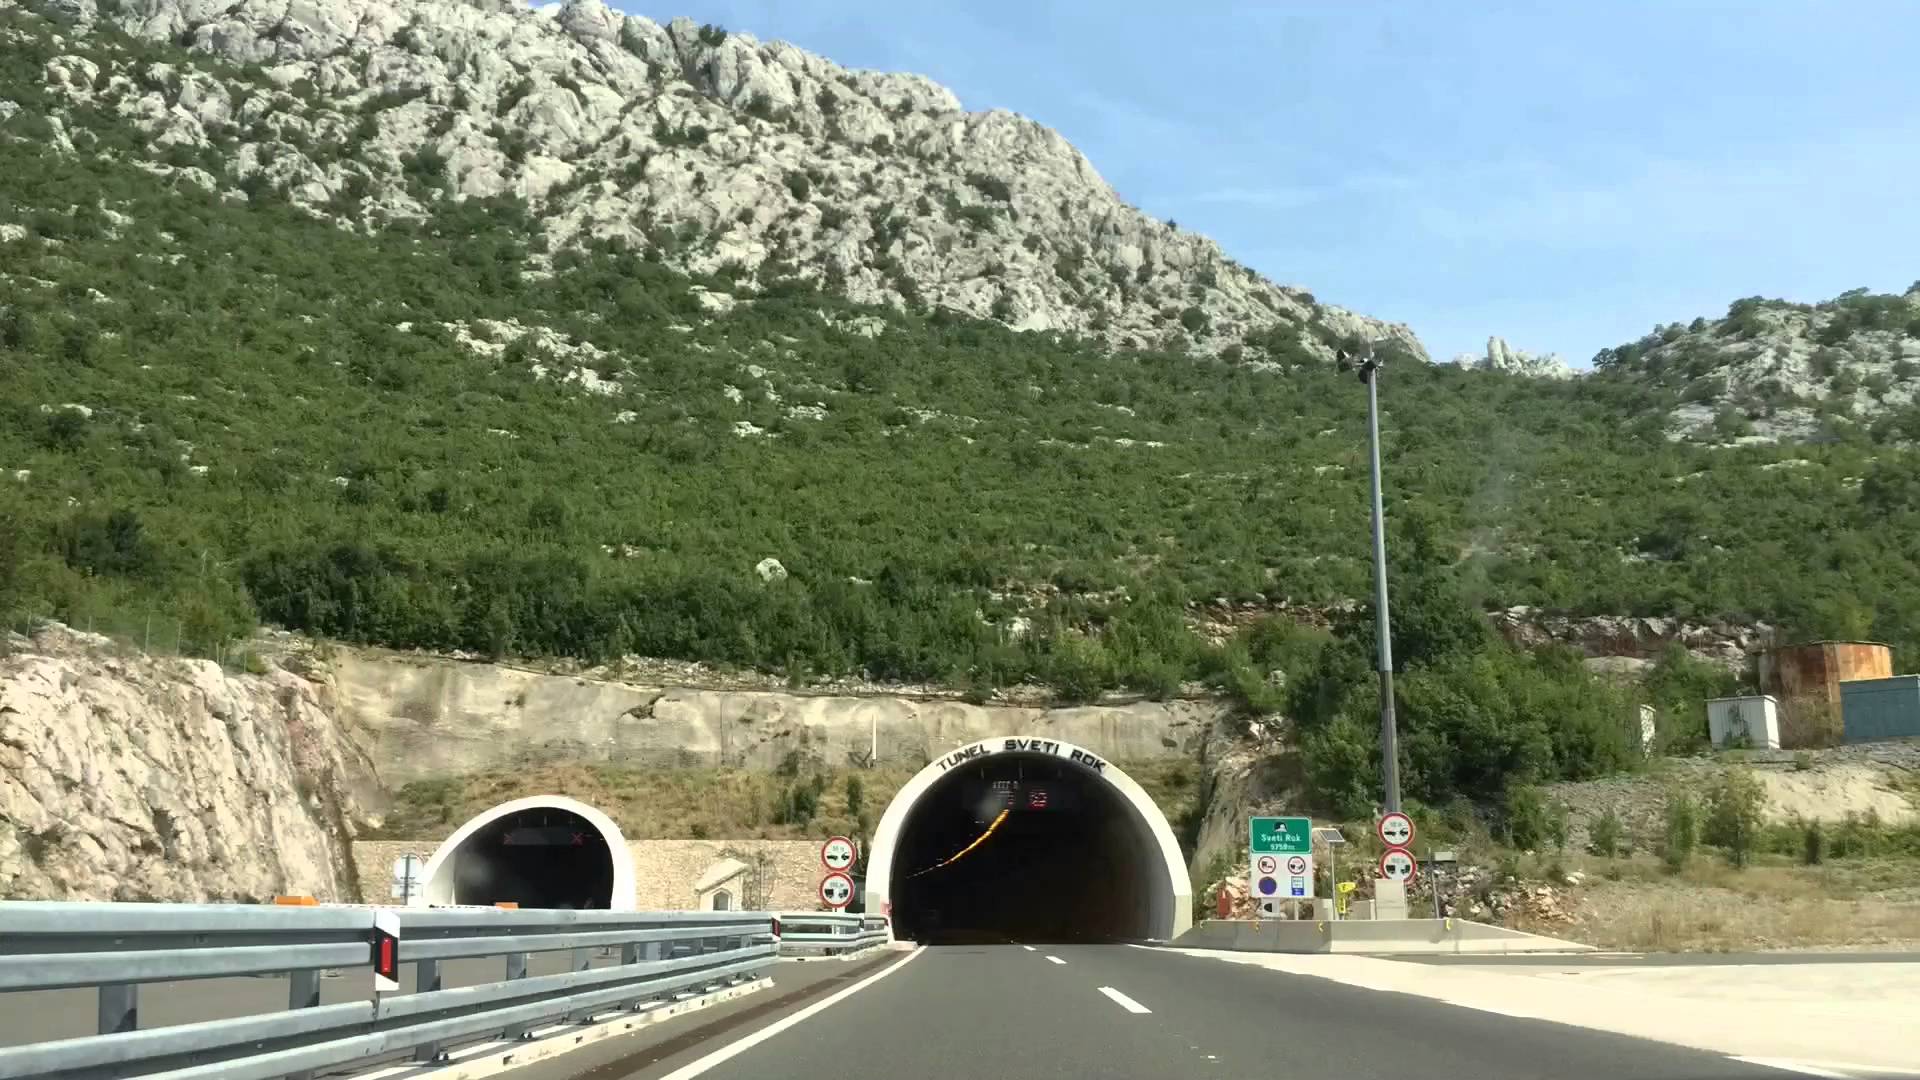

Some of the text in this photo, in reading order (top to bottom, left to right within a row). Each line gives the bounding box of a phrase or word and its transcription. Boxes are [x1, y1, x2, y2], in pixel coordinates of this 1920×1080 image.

[936, 739, 1106, 772] TUNEL SVETI ROK
[1261, 833, 1301, 842] Sveti Rok
